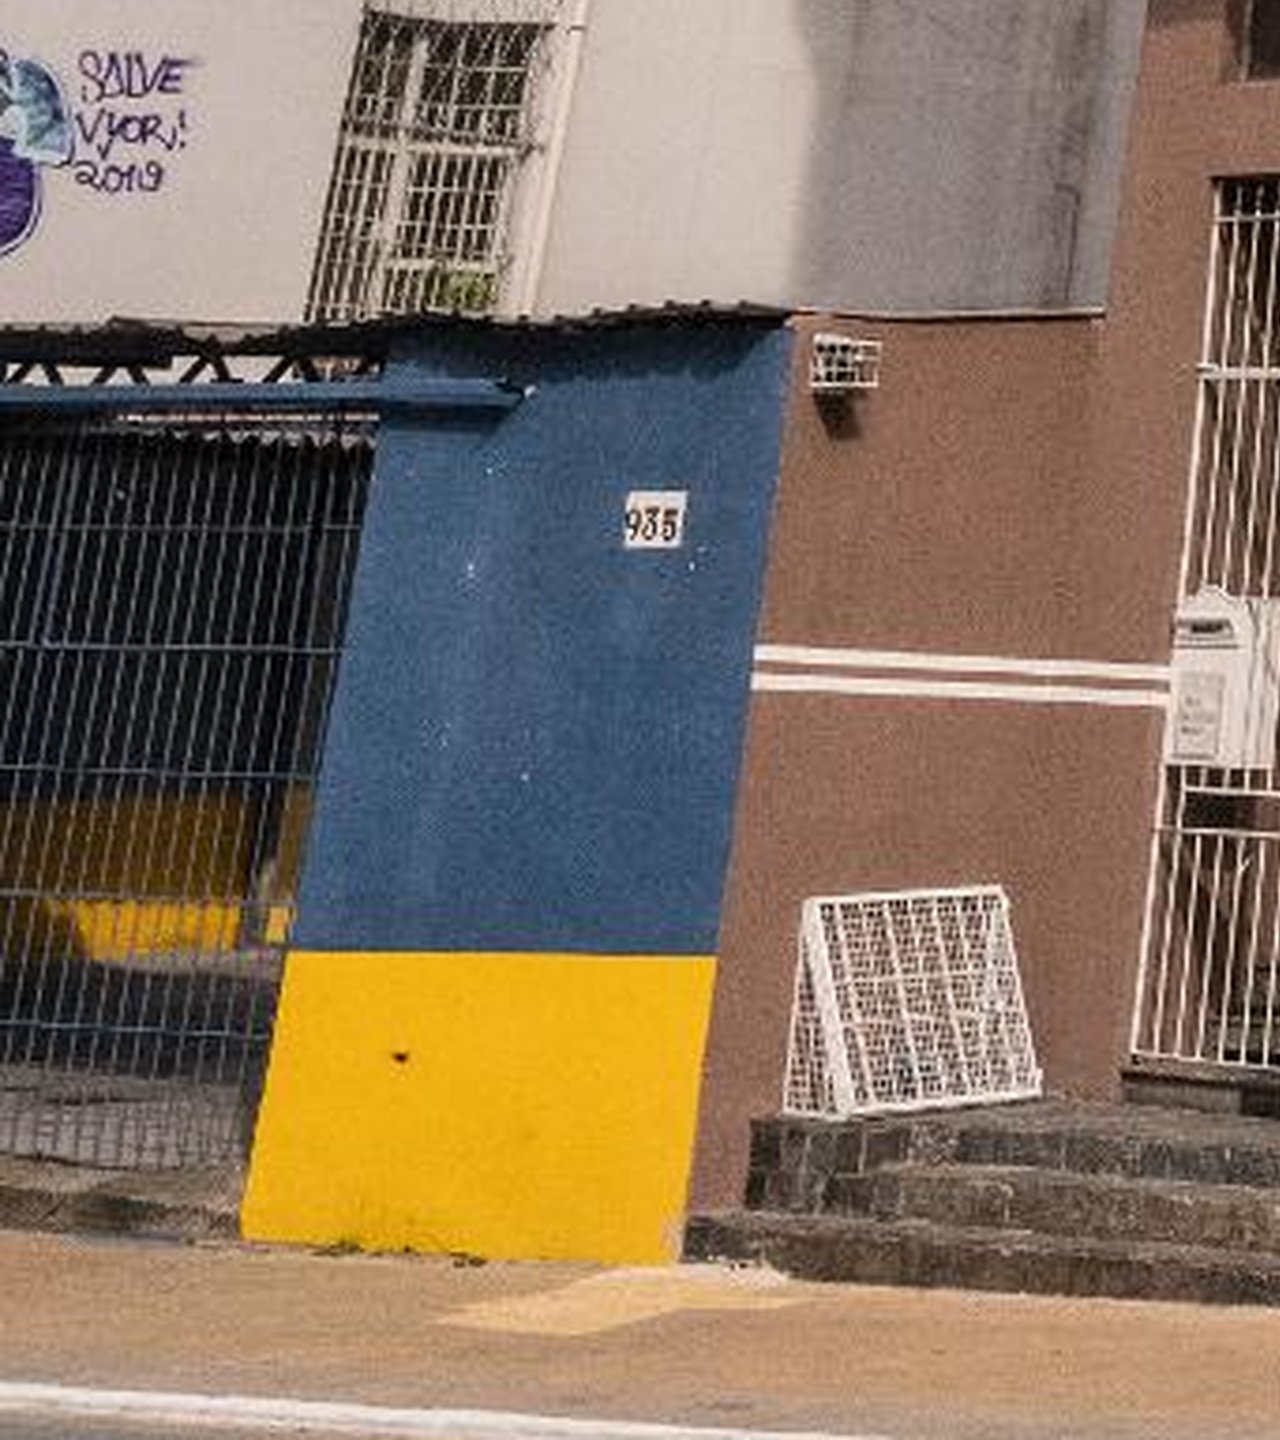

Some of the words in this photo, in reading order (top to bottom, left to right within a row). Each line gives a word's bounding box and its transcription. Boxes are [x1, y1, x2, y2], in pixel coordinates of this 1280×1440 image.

[77, 50, 200, 104] SALVE
[72, 160, 164, 193] 2019
[624, 506, 679, 542] 935
